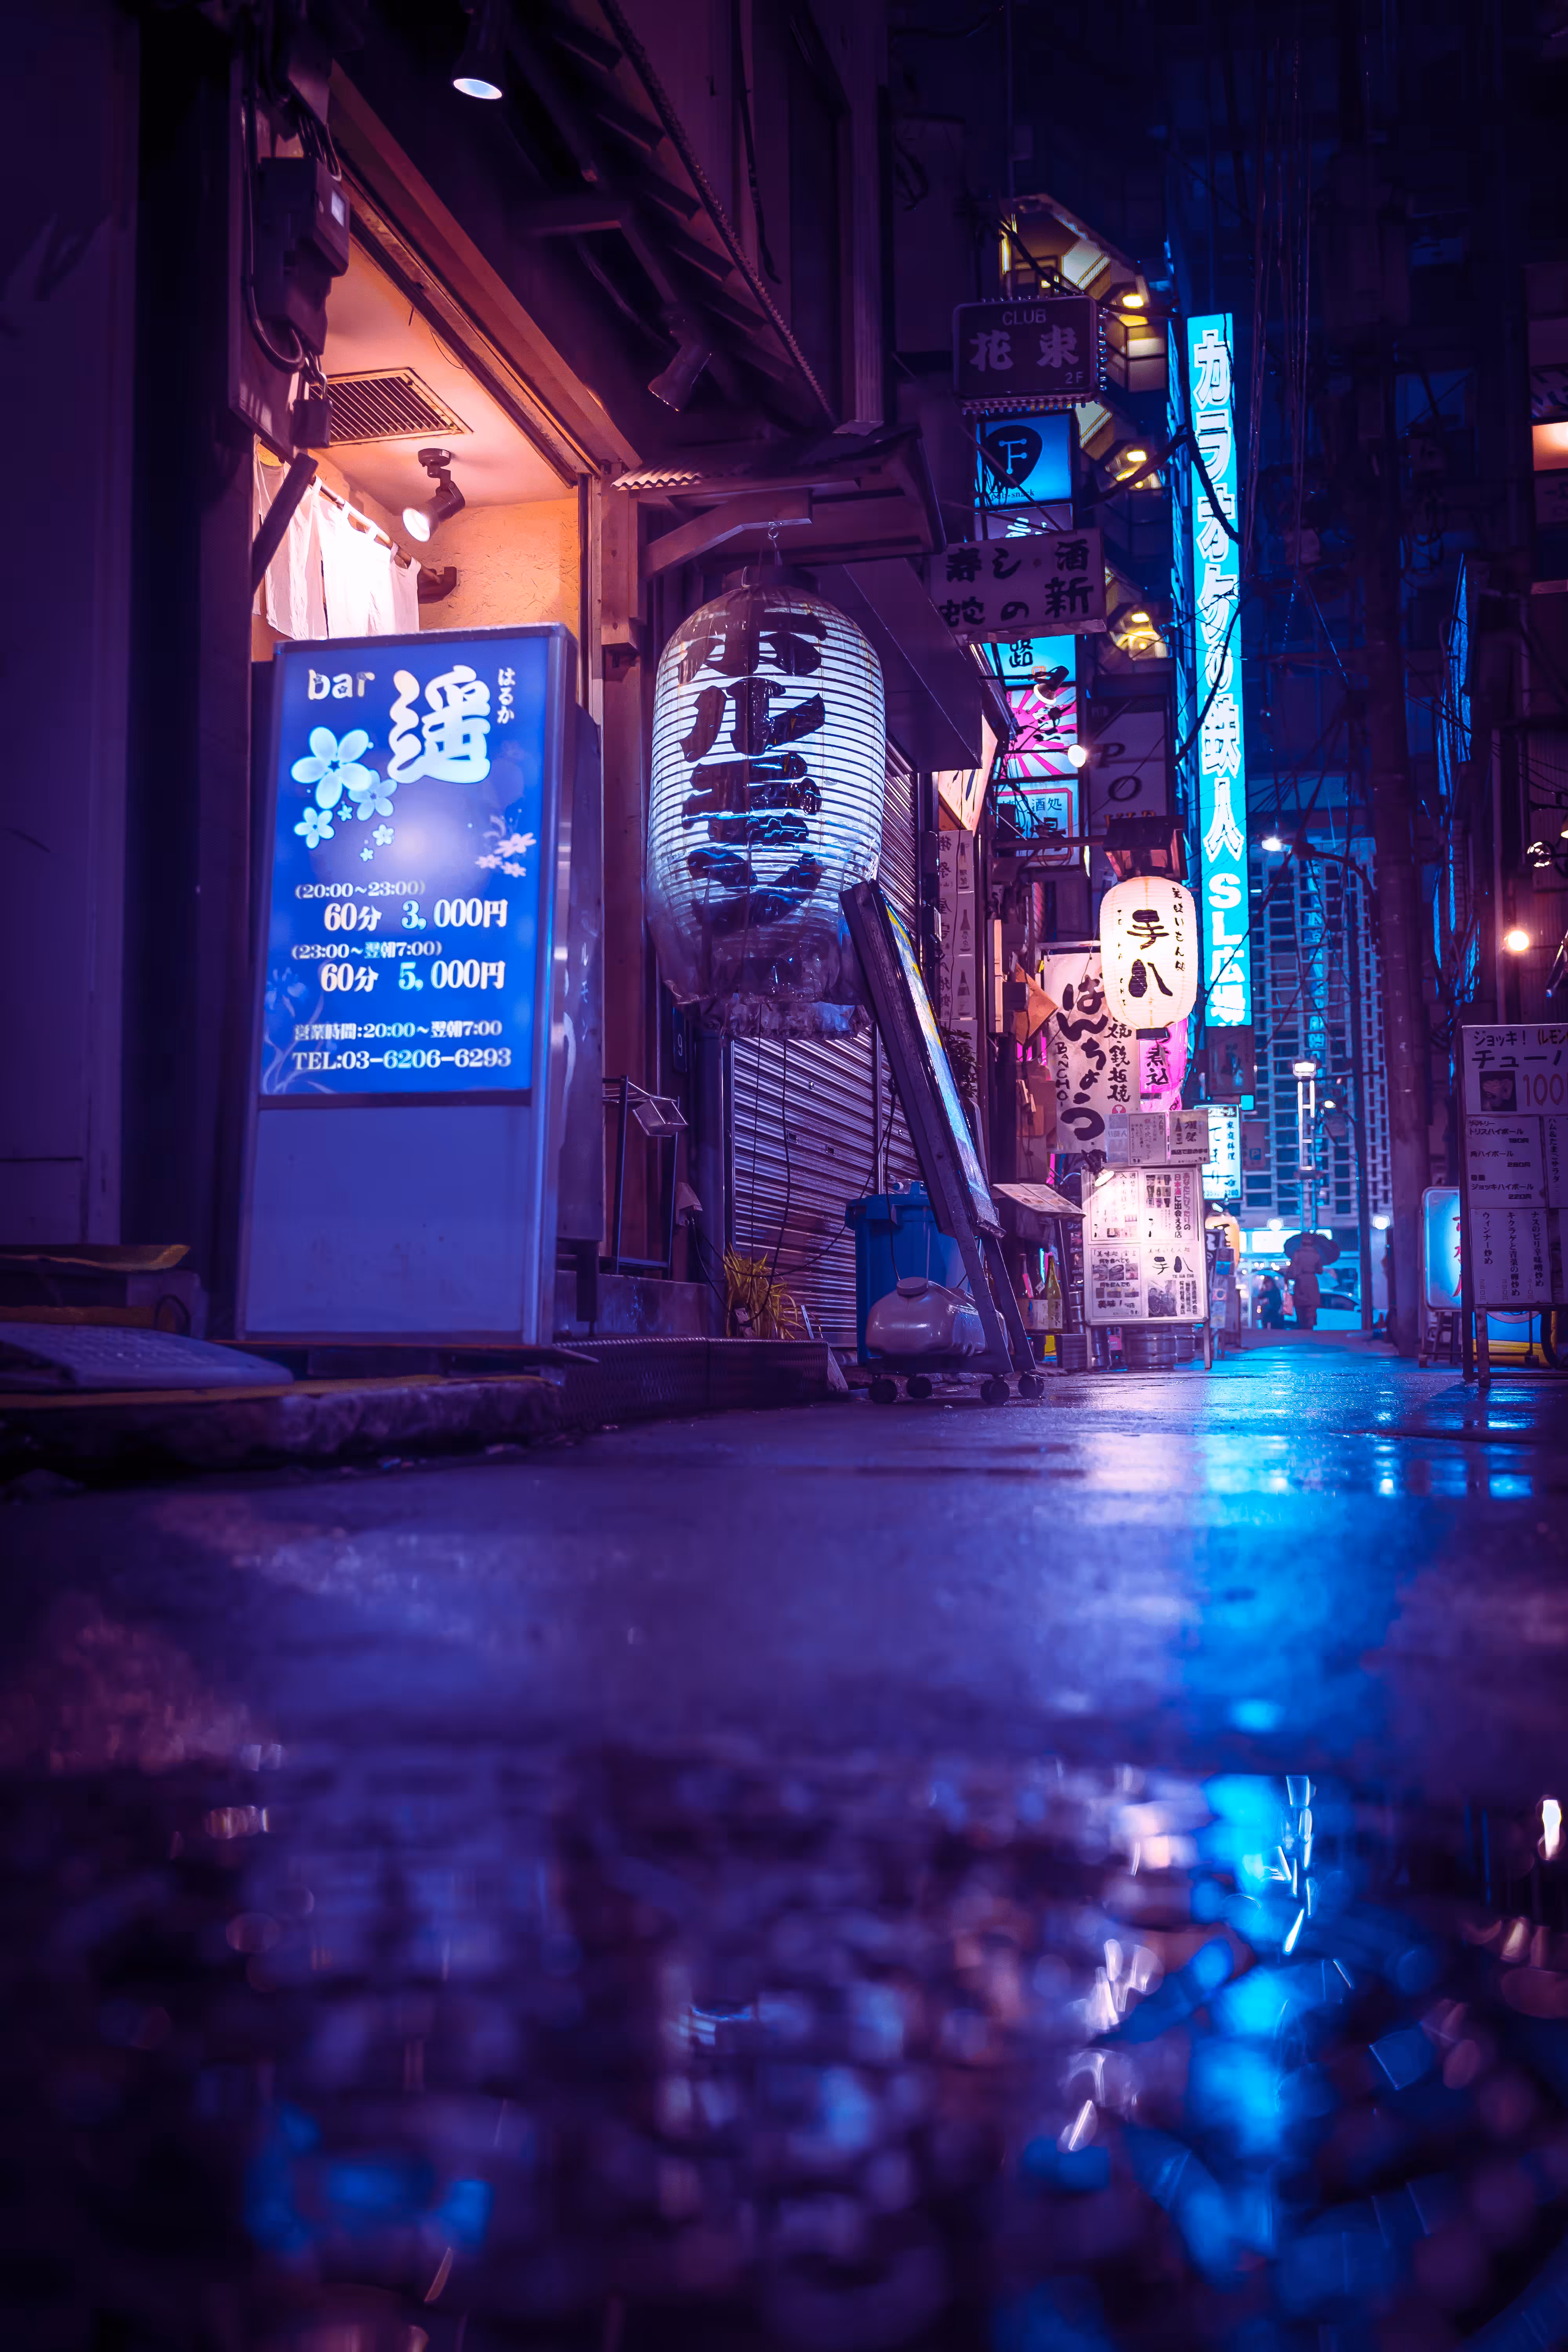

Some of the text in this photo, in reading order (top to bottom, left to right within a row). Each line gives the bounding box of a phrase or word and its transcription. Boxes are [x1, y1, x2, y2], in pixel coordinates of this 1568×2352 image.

[1002, 309, 1047, 326] CLUB
[307, 669, 376, 701] bar
[497, 667, 516, 724] はるか
[323, 902, 382, 931] 60分
[1208, 873, 1247, 1026] SL広場
[320, 963, 379, 992] 60分
[1523, 1073, 1568, 1107] 100
